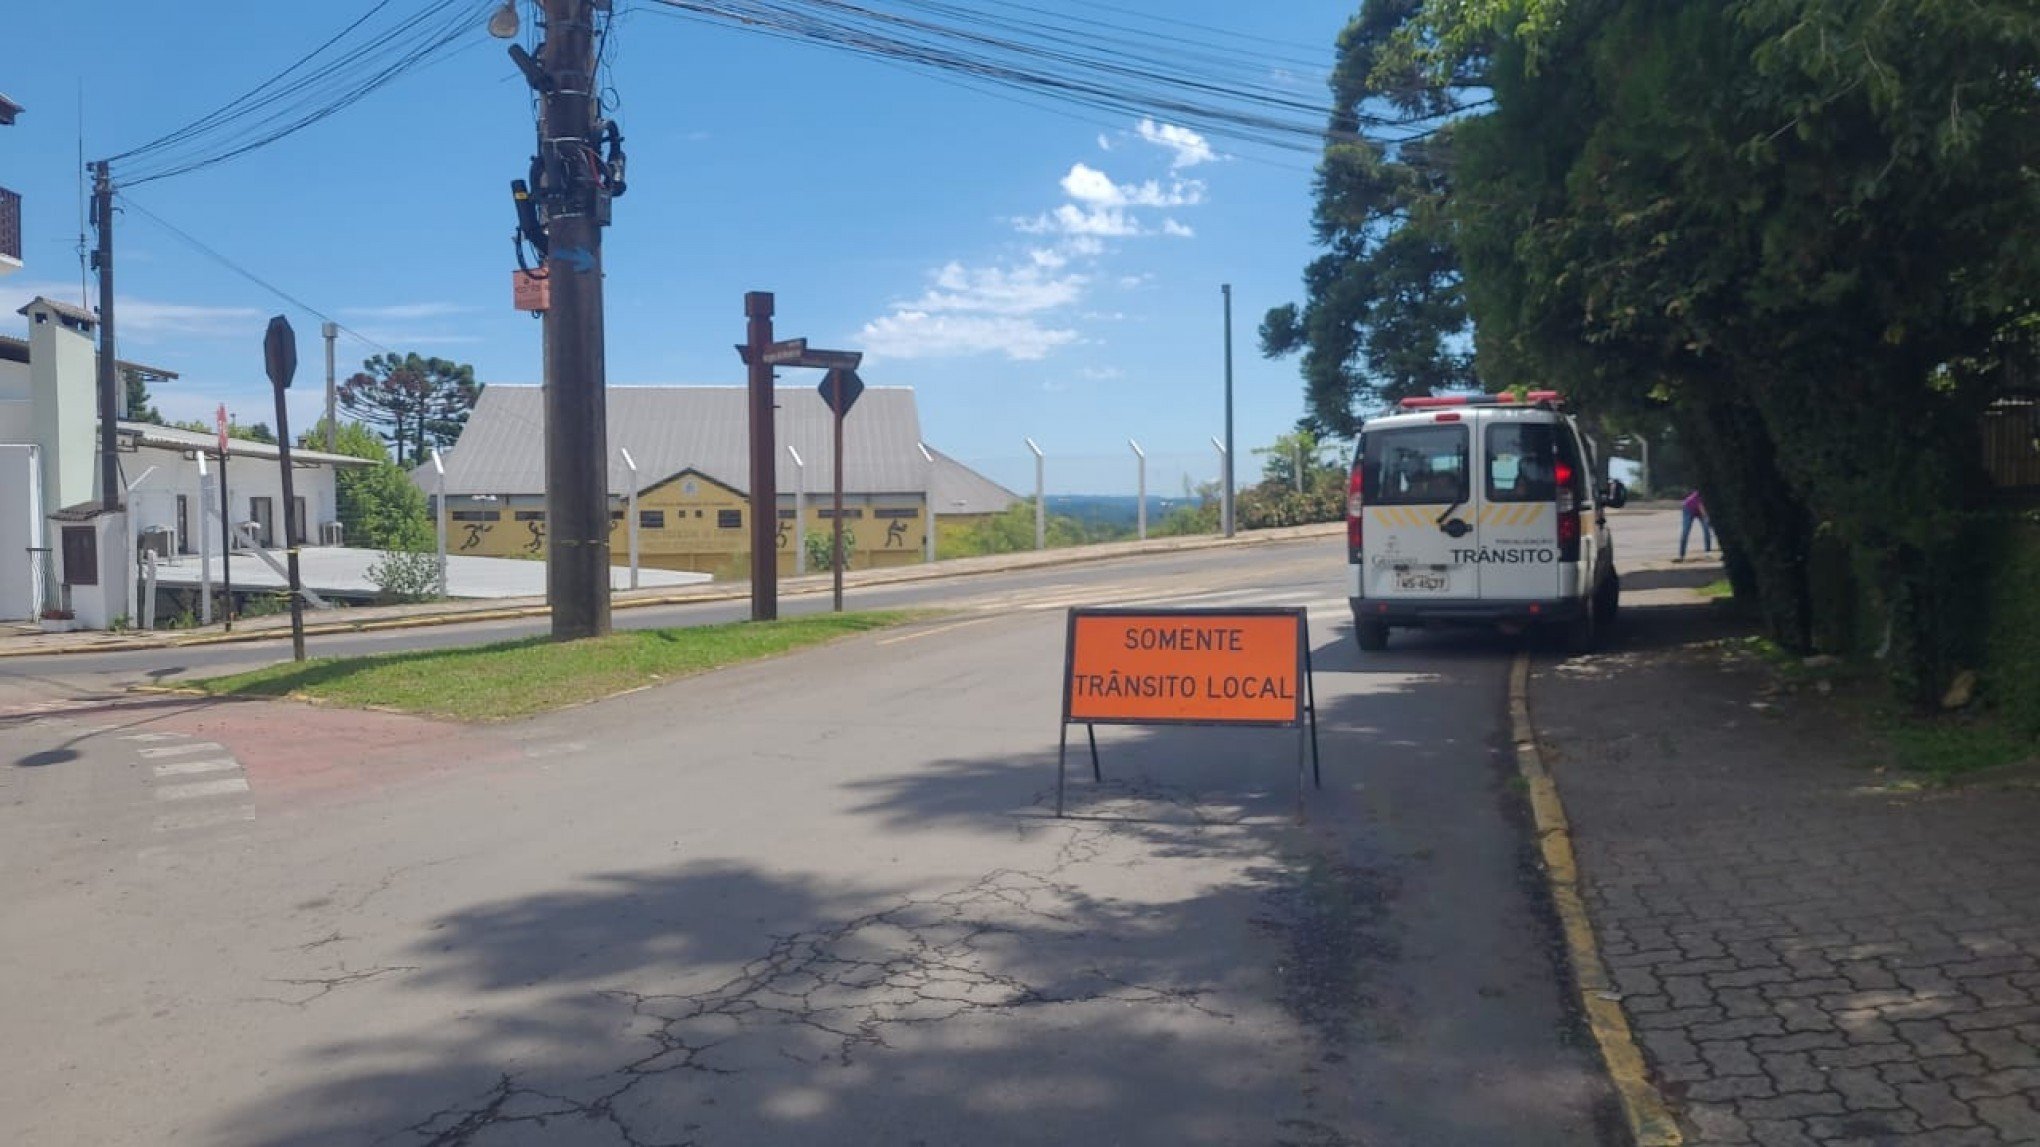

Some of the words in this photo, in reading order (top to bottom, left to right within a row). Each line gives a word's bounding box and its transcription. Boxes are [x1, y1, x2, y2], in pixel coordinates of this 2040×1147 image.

[1452, 545, 1553, 563] TRÂNSITO
[1125, 628, 1243, 650] SOMENTE
[1075, 669, 1196, 697] TRÂNSITO
[1208, 676, 1294, 698] LOCAL
